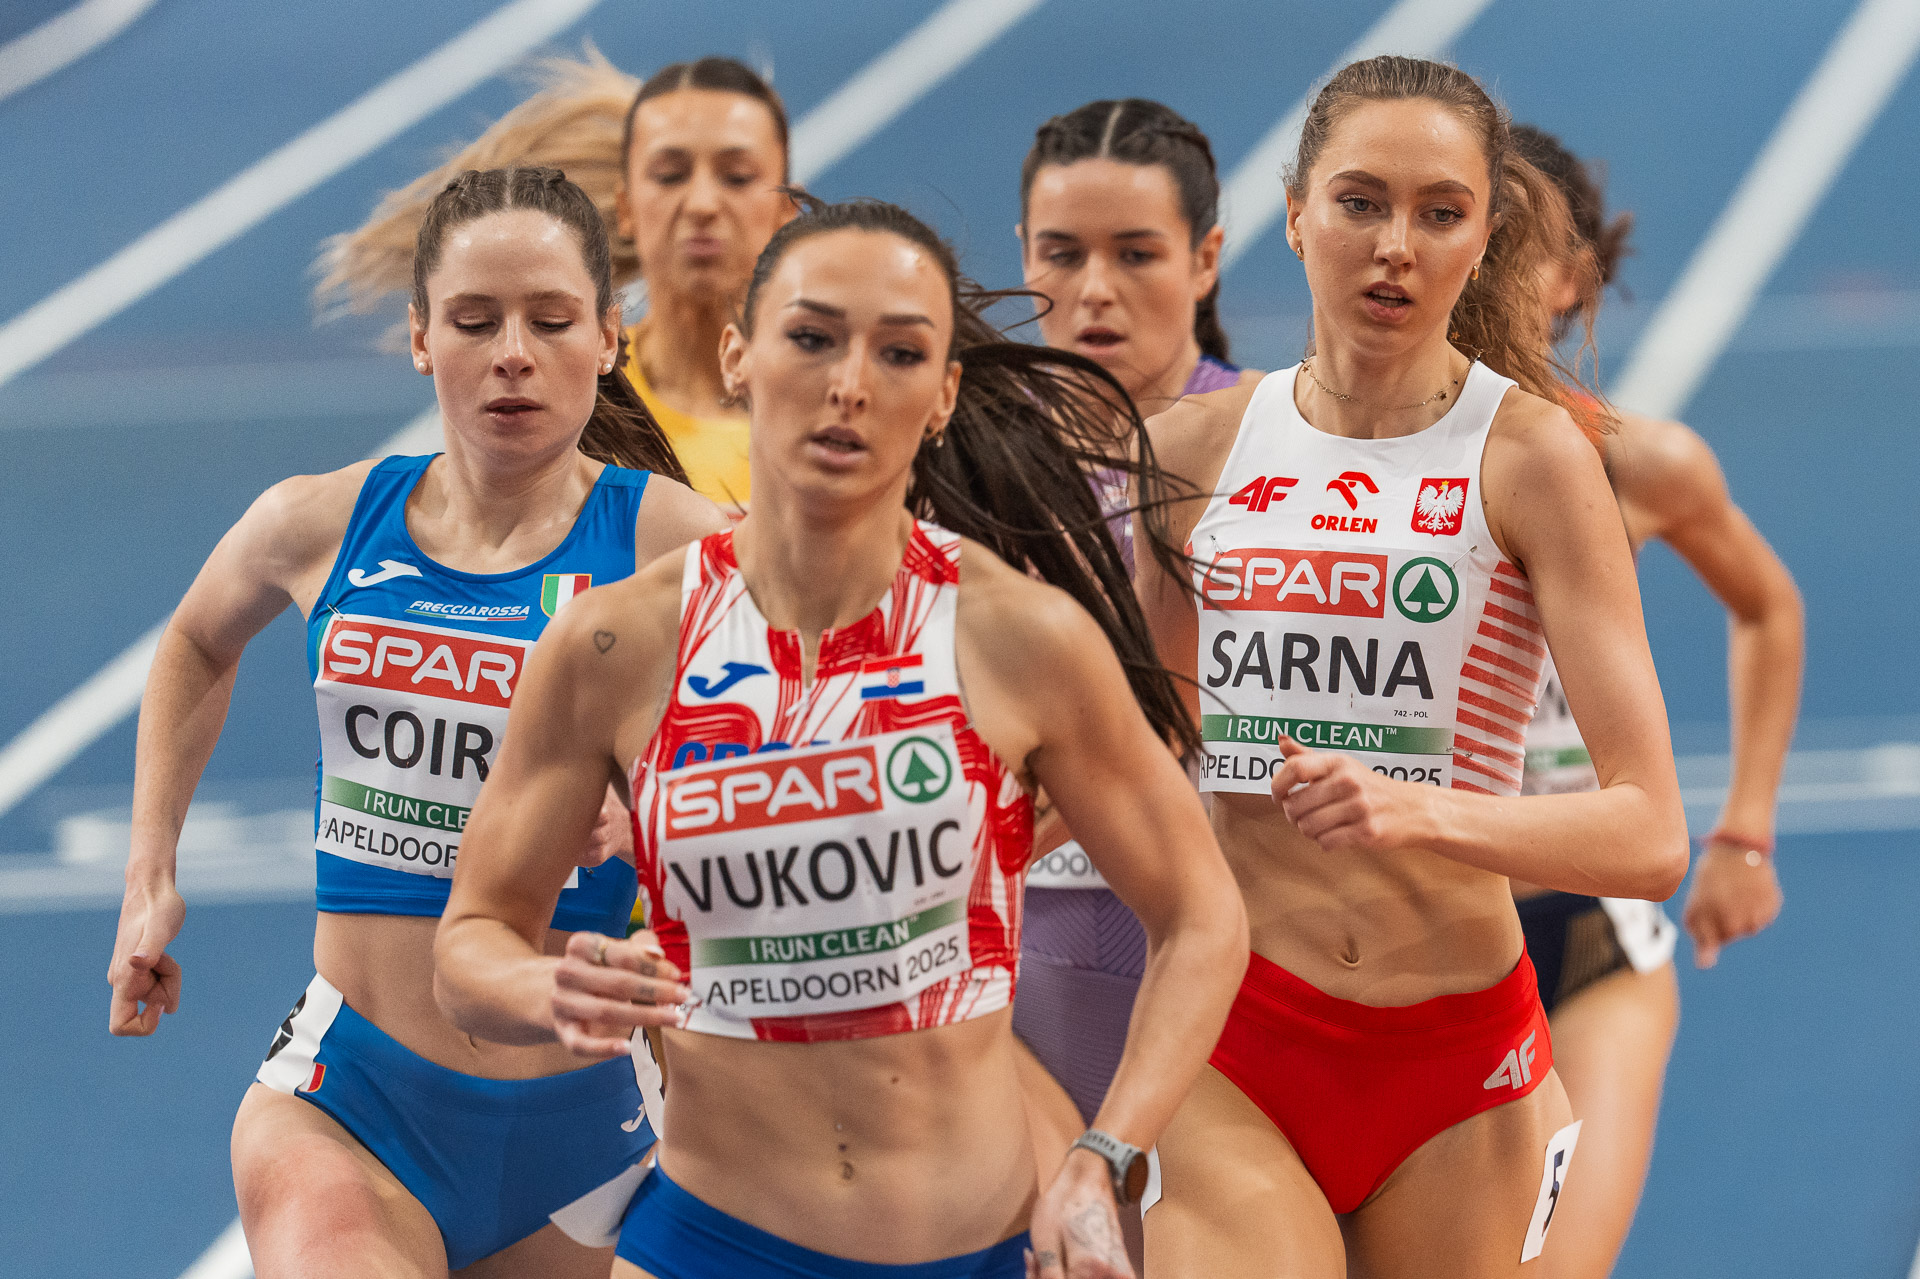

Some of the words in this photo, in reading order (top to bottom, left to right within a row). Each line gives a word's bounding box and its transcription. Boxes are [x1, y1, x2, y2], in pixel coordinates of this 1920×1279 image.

[1228, 475, 1299, 512] 4F
[1310, 514, 1378, 534] ORLEN
[1205, 554, 1381, 608] SPAR
[409, 600, 531, 617] FRECCIAROSSA
[329, 629, 516, 699] SPAR
[1206, 629, 1434, 700] SARNA
[1226, 718, 1233, 738] I
[1236, 718, 1290, 741] RUN
[363, 789, 371, 809] I
[373, 792, 420, 822] RUN
[670, 756, 878, 830] SPAR
[669, 819, 964, 913] VUKOVIC
[707, 963, 901, 1005] APELDOORN
[906, 935, 959, 981] 2025
[749, 939, 758, 961] I
[761, 936, 817, 962] RUN
[1482, 1028, 1536, 1090] 4F
